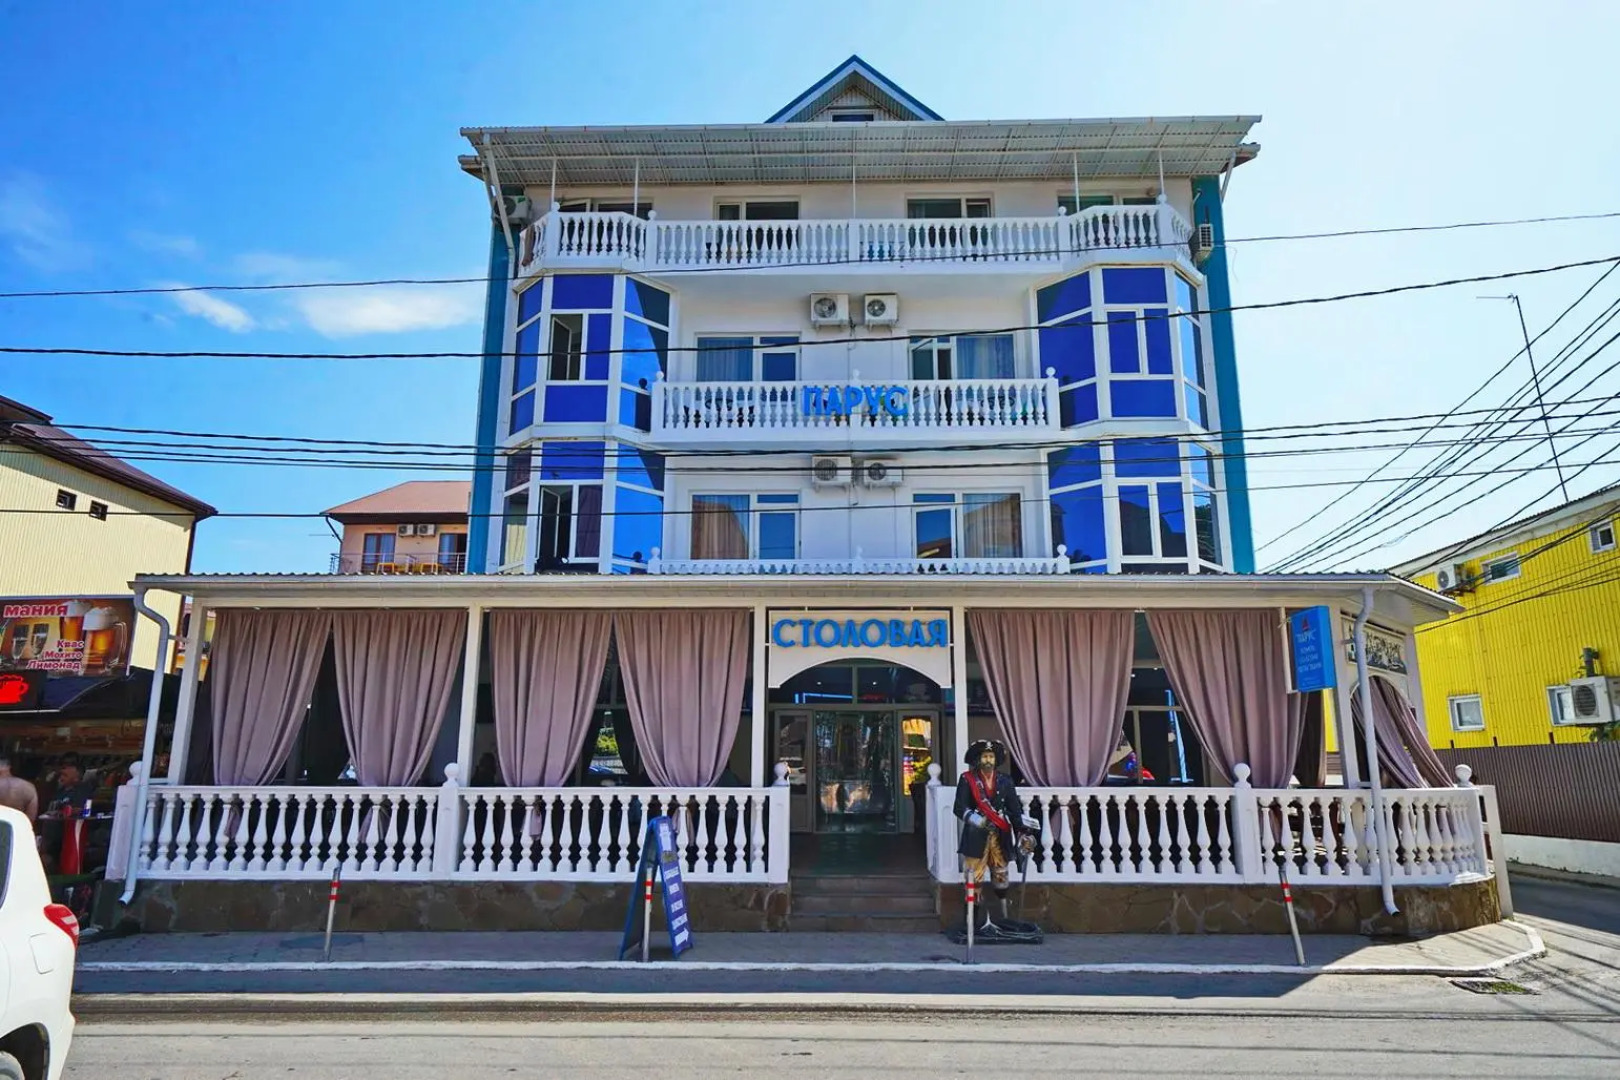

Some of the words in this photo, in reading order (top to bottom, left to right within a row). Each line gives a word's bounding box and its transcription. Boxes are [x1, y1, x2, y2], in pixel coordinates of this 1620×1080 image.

[803, 385, 910, 417] ПАРУС
[3, 604, 68, 618] мания
[772, 618, 948, 648] СТОЛОВАЯ
[57, 640, 85, 649] Квас
[44, 651, 83, 660] Мохито
[27, 660, 81, 670] Лимонад
